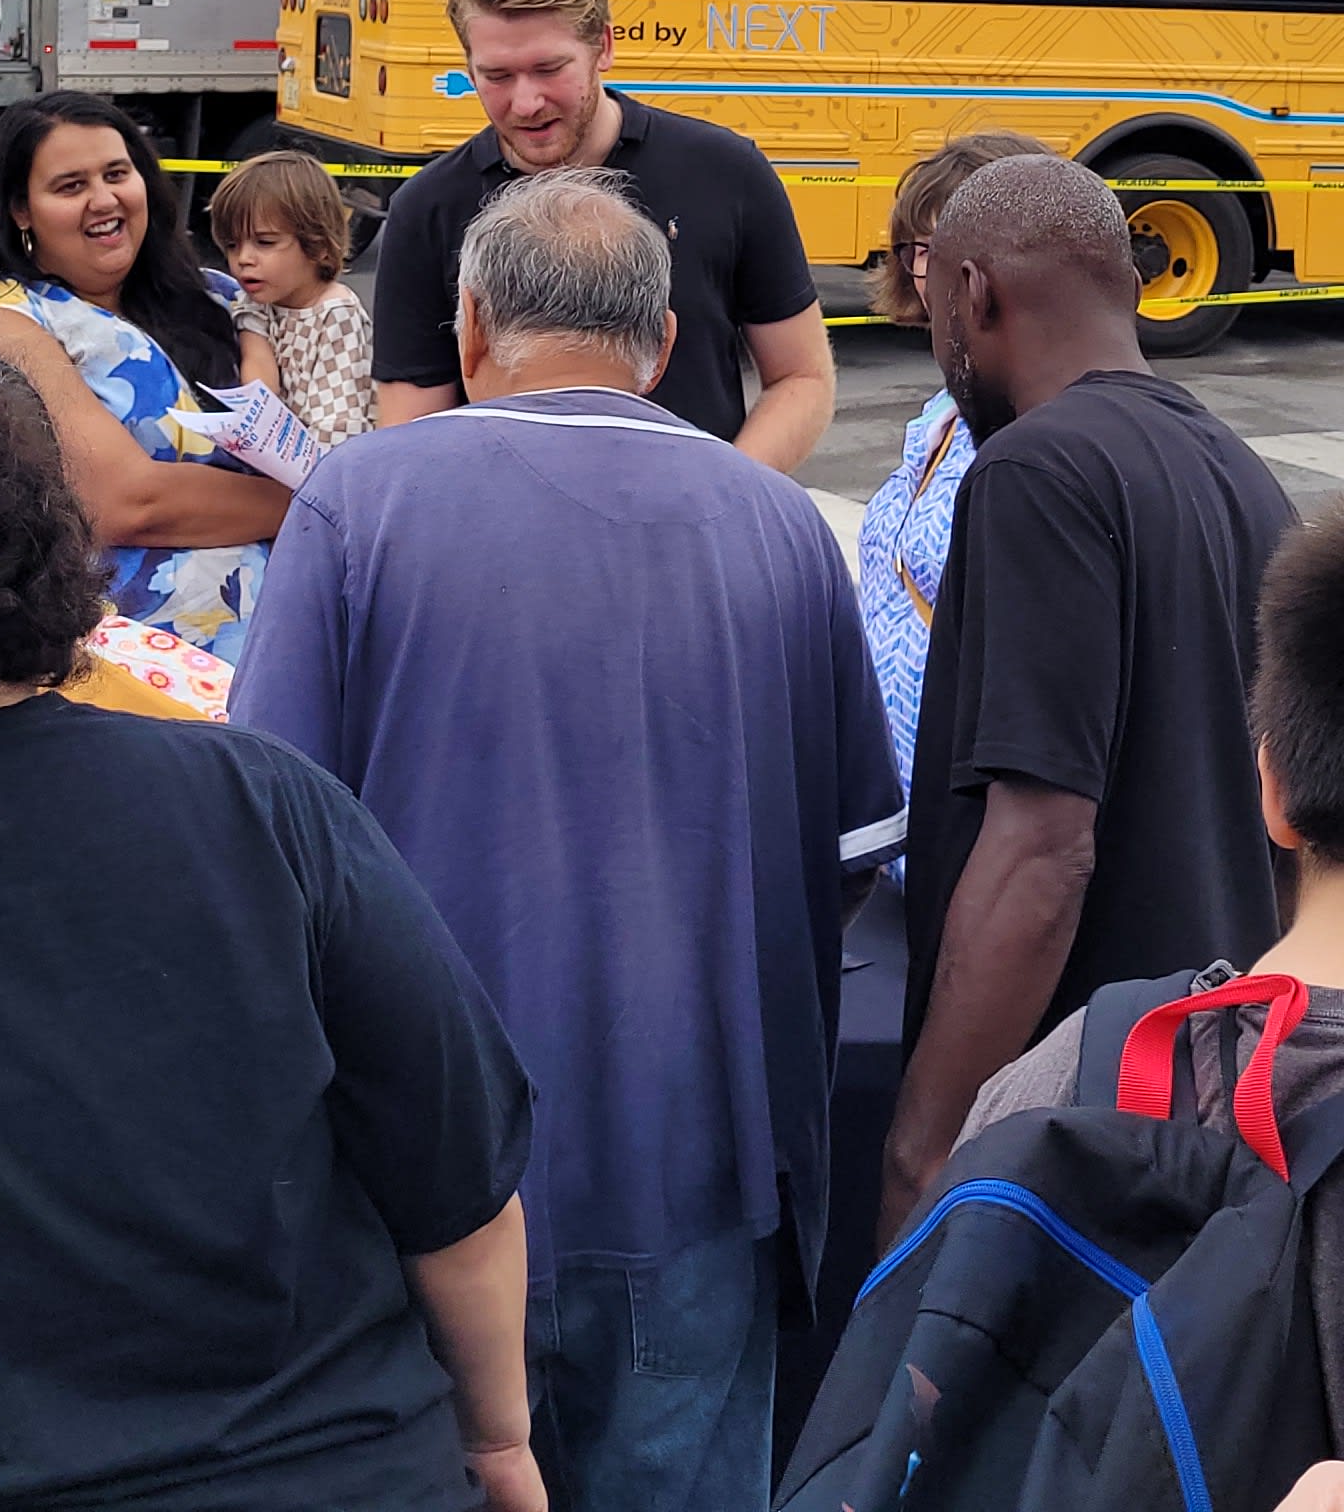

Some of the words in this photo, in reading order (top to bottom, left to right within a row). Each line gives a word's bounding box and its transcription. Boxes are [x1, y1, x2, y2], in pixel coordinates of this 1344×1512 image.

[613, 21, 644, 41] ed
[655, 21, 687, 47] by
[707, 2, 838, 53] NEXT
